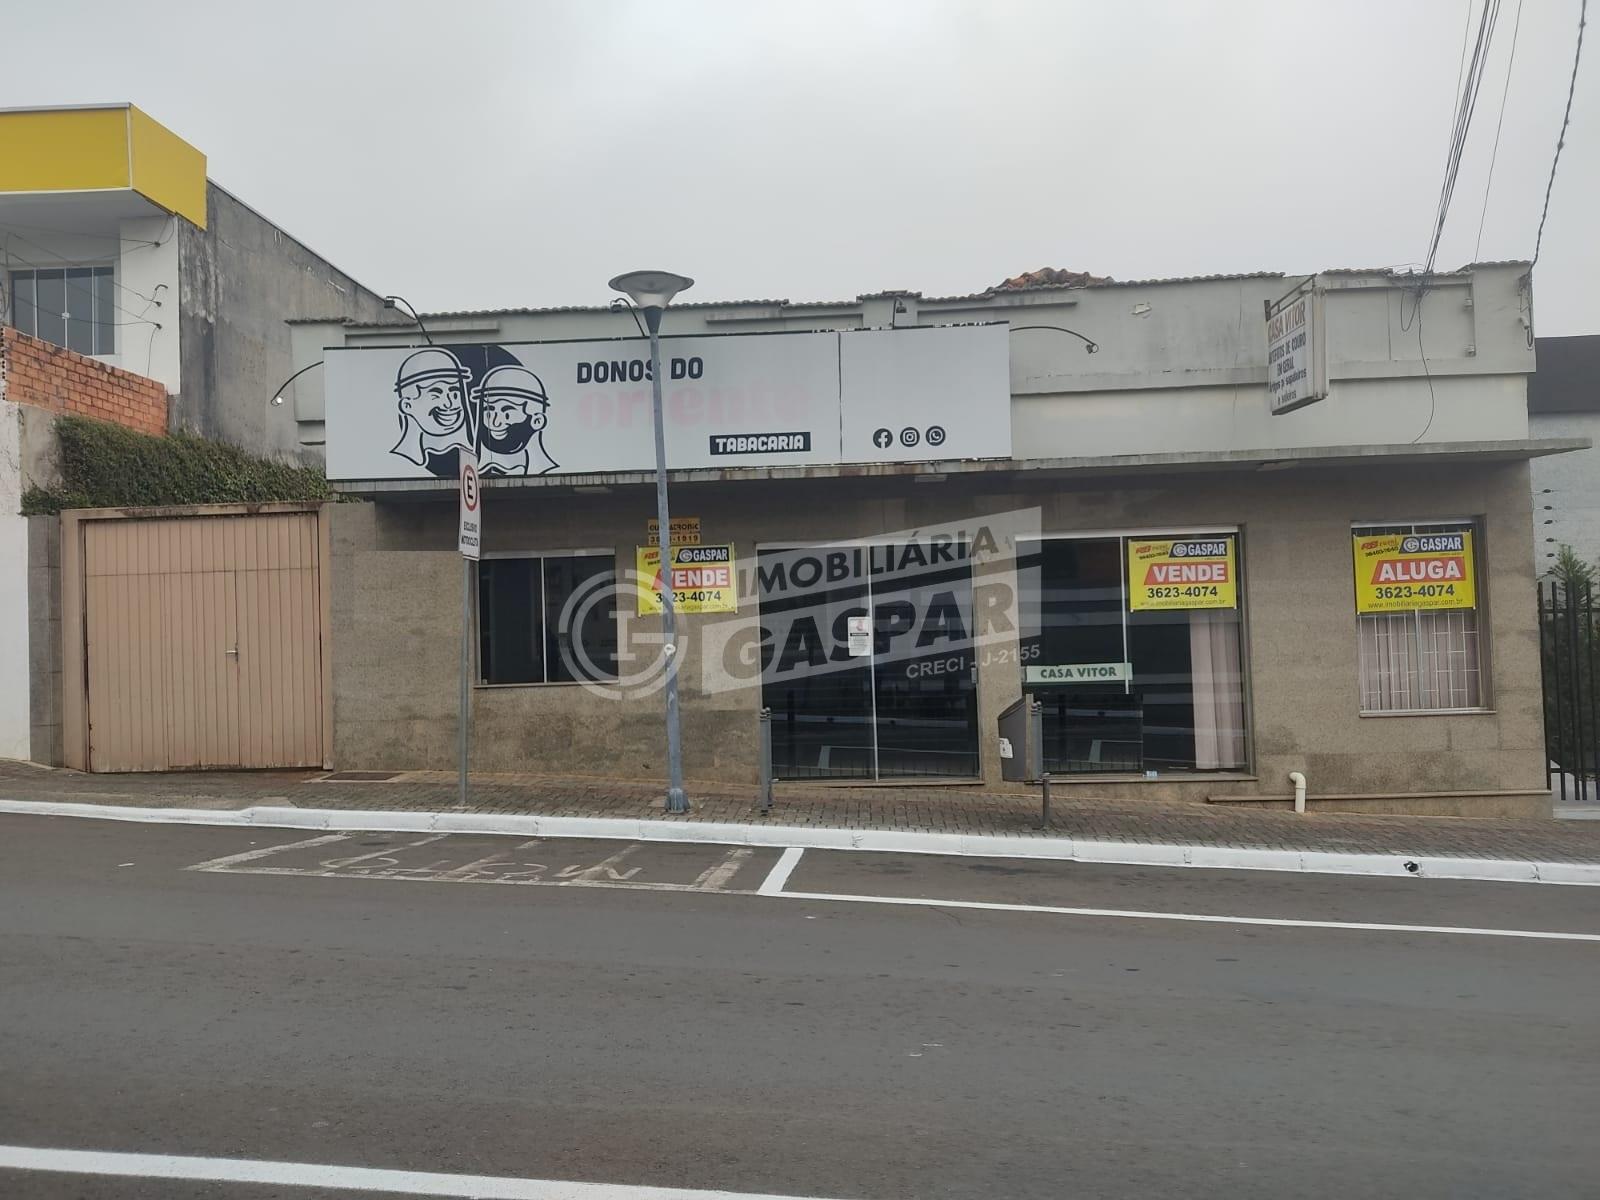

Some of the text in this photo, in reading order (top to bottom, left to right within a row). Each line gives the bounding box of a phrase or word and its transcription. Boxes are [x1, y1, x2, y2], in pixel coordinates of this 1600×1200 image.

[1285, 300, 1306, 333] VITOR
[670, 356, 704, 380] DO
[715, 434, 804, 453] TABACARIA
[467, 474, 474, 500] E
[1187, 543, 1226, 556] GASPAR
[1420, 536, 1462, 551] GASPAR
[693, 549, 728, 561] GASPAR
[1152, 563, 1226, 583] VENDE
[1379, 560, 1462, 582] ALUGA
[655, 590, 722, 603] 323-4074
[1147, 586, 1218, 599] 3623-4074
[1375, 584, 1455, 600] 3623-4074
[1040, 666, 1117, 679] CASA VITOR
